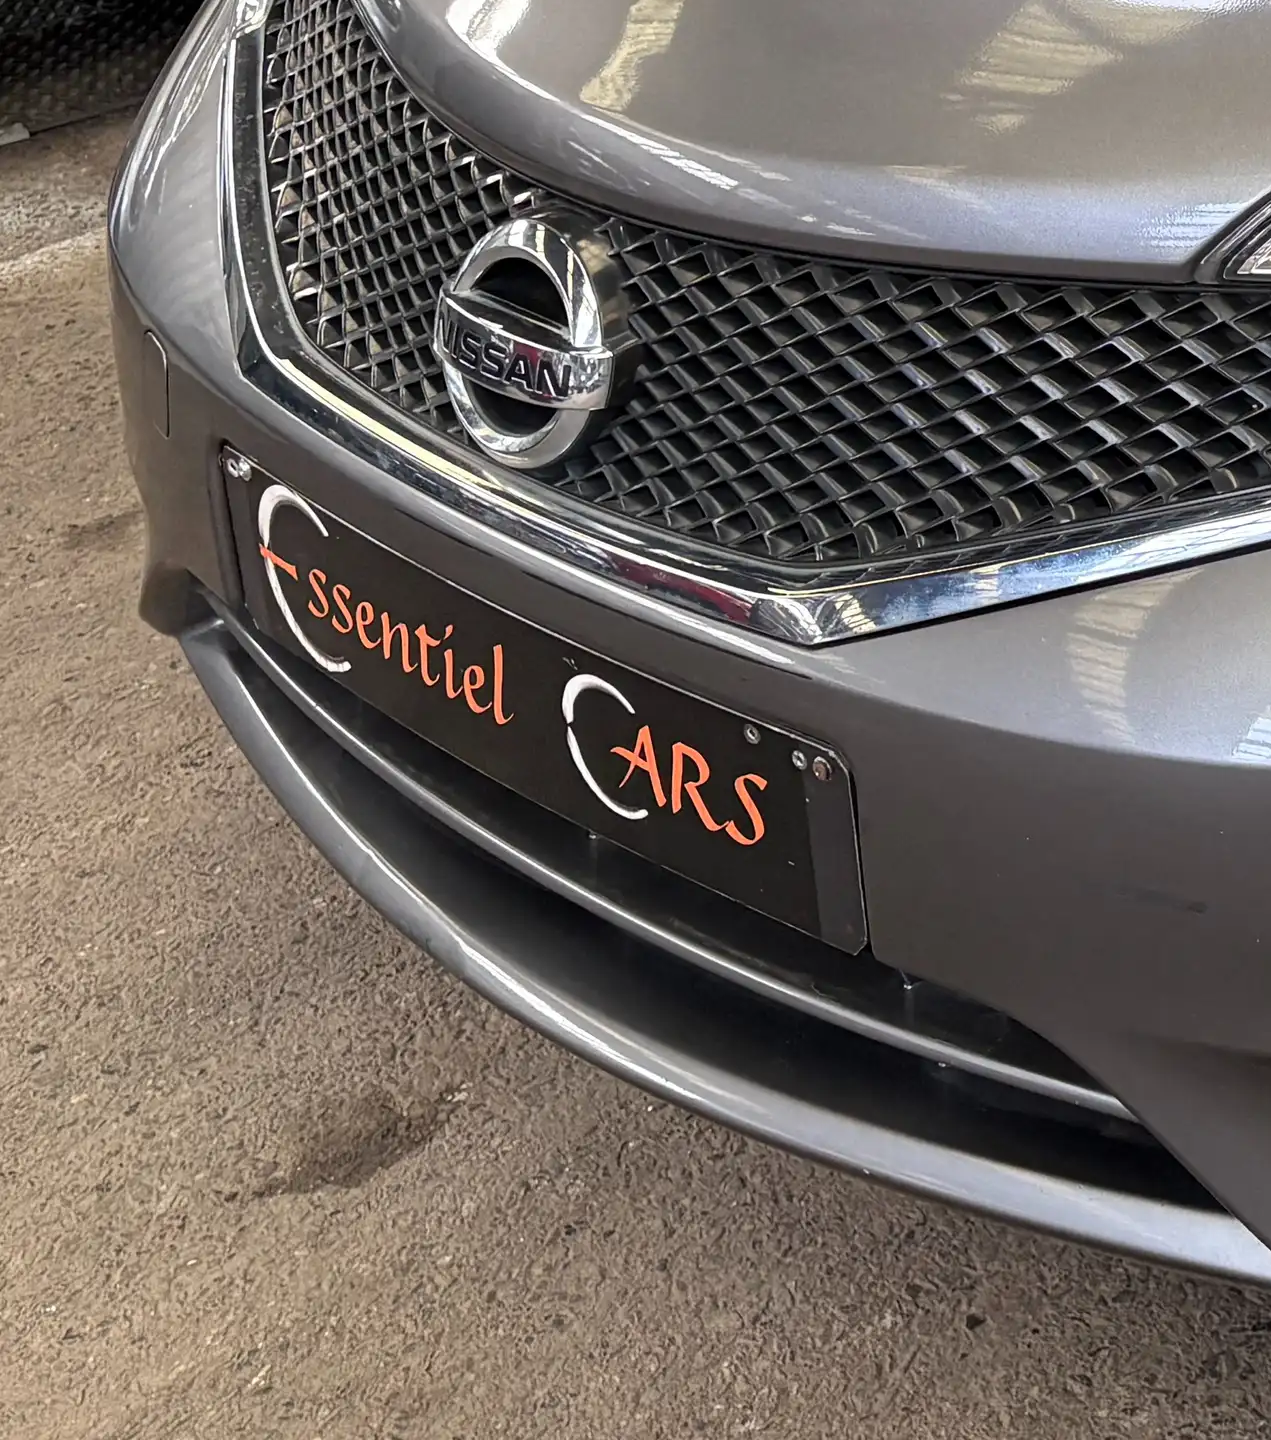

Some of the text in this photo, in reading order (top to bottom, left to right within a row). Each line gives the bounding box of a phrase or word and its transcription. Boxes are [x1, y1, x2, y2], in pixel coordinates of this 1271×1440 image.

[438, 311, 571, 400] NISSAN
[257, 484, 768, 846] Essentiel CARS
